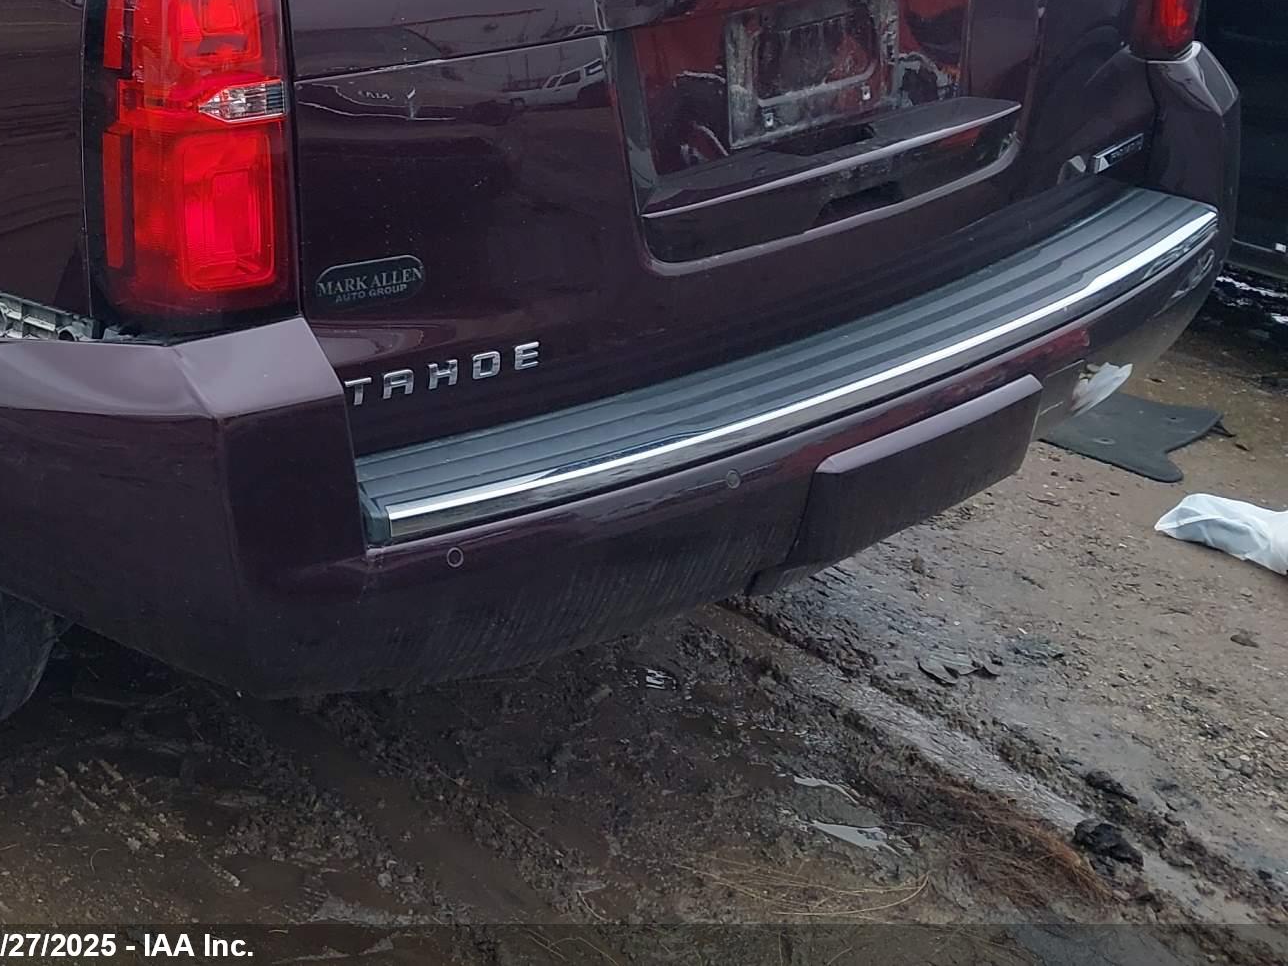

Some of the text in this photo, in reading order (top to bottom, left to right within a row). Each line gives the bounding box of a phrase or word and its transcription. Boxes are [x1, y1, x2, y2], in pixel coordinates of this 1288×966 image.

[317, 265, 423, 296] MARK ALLEN
[335, 283, 408, 303] AUTO GROUP
[344, 341, 540, 406] TAHOE
